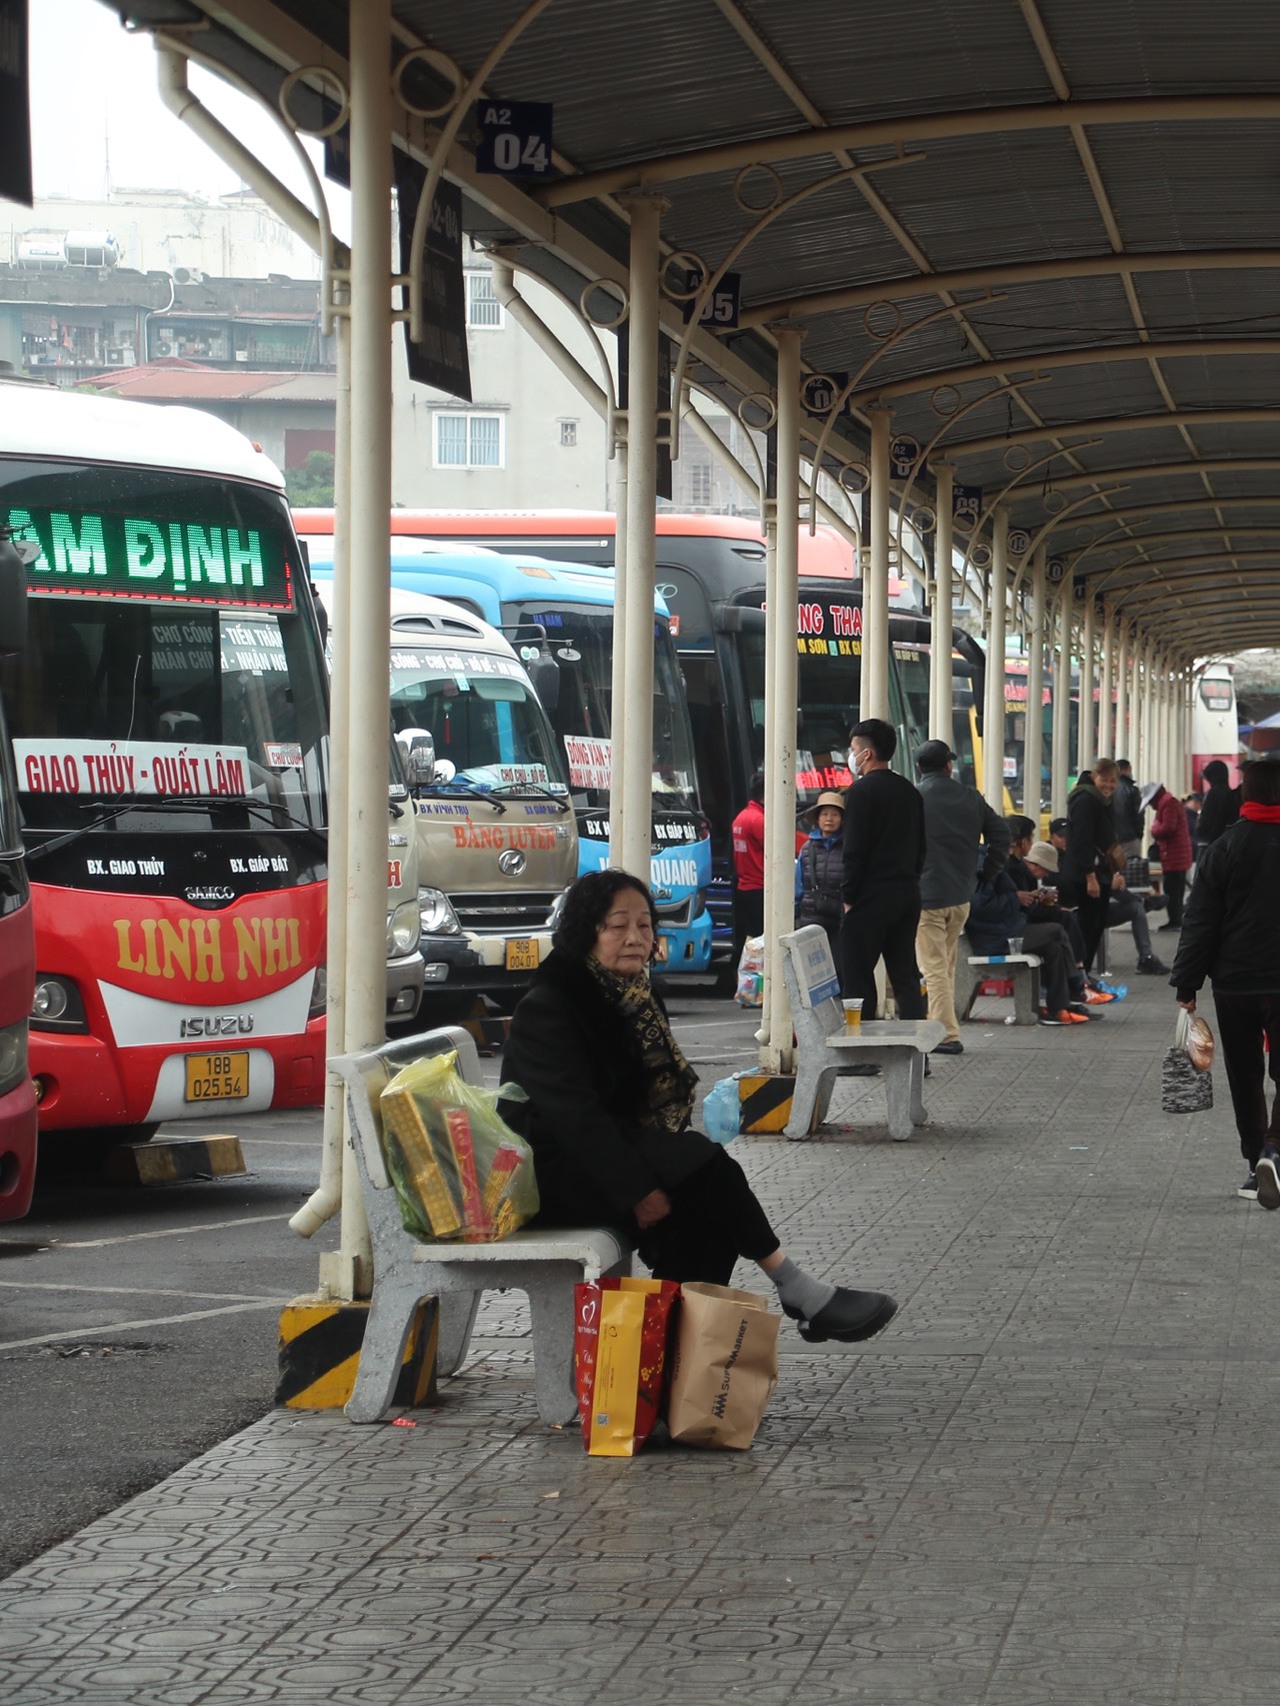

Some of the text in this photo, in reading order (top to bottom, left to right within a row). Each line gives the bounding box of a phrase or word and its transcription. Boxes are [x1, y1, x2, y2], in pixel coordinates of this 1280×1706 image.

[484, 108, 511, 125] A2
[494, 133, 548, 171] 04
[124, 518, 264, 592] ĐỊNH
[153, 626, 182, 648] CHỢ
[25, 754, 79, 794] GIAO
[83, 743, 136, 794] THỦY
[205, 752, 246, 796] LÂM
[420, 804, 432, 814] BX
[654, 825, 668, 839] BX
[87, 856, 165, 875] BX. GIAO THỦY
[230, 855, 289, 873] BX. GIÁP BÁT
[184, 886, 235, 900] SAMCO
[113, 917, 301, 983] LINH NHI
[180, 1014, 254, 1038] ISUZU
[207, 1057, 231, 1075] 18B
[193, 1077, 241, 1098] 025.54
